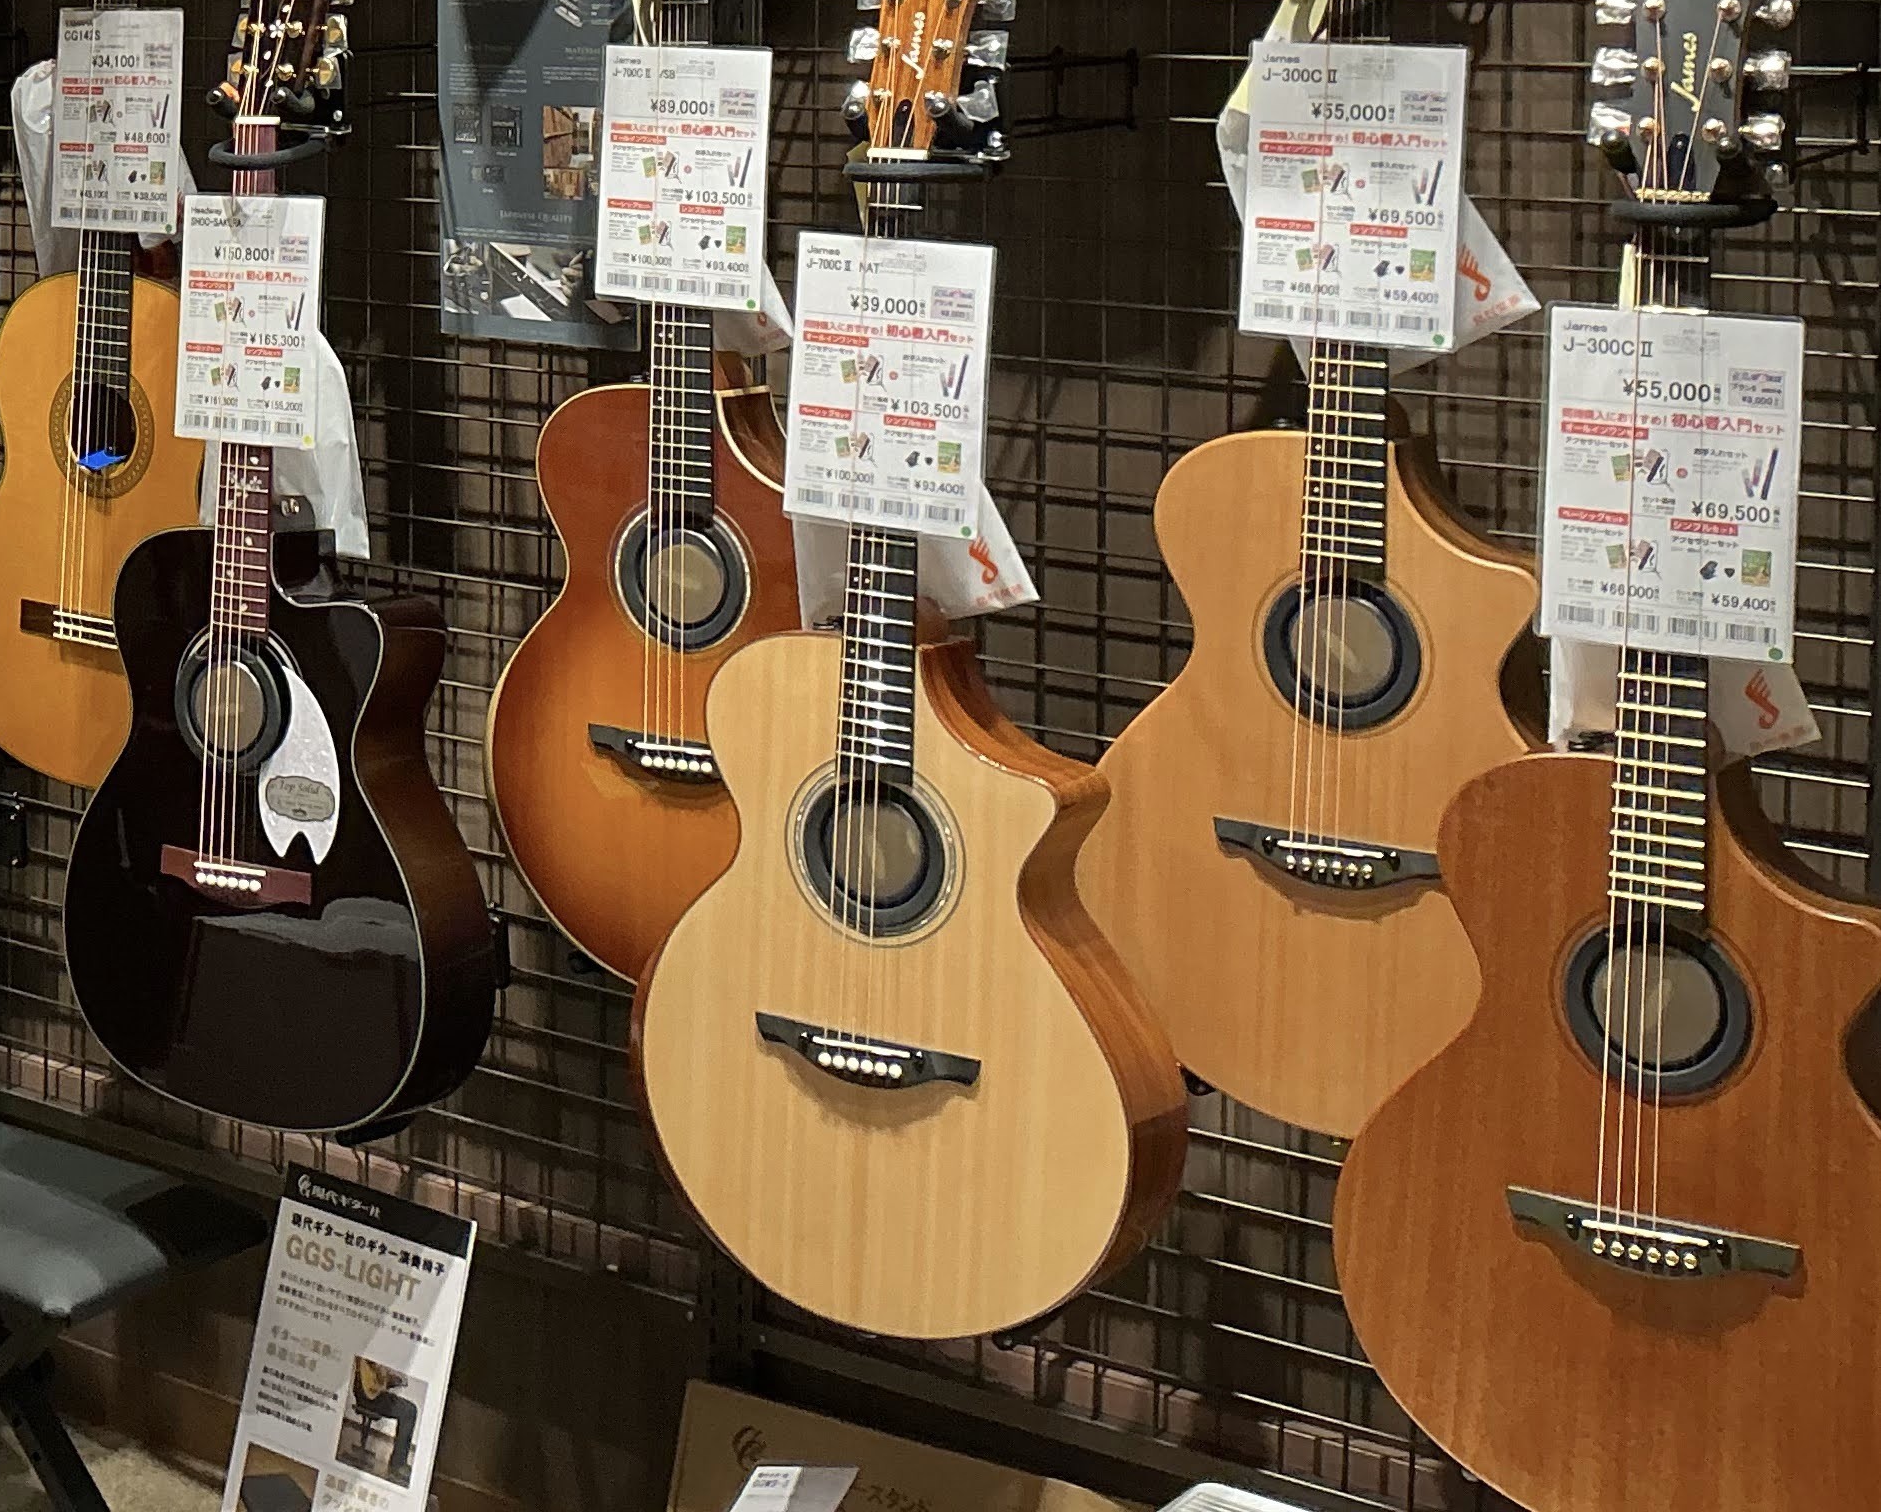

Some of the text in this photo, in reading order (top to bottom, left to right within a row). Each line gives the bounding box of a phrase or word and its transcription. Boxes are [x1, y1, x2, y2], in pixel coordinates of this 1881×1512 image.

[1263, 54, 1301, 64] James
[651, 98, 708, 116] ¥89,000
[1312, 102, 1386, 122] ¥55,000
[685, 189, 746, 207] ¥103,500
[1369, 207, 1436, 227] ¥69,500
[806, 245, 841, 256] James
[1563, 321, 1608, 333] James
[1623, 378, 1712, 403] ¥55,000
[890, 397, 962, 420] ¥103,500
[1691, 500, 1770, 524] ¥69,500
[1711, 592, 1770, 611] ¥59,400
